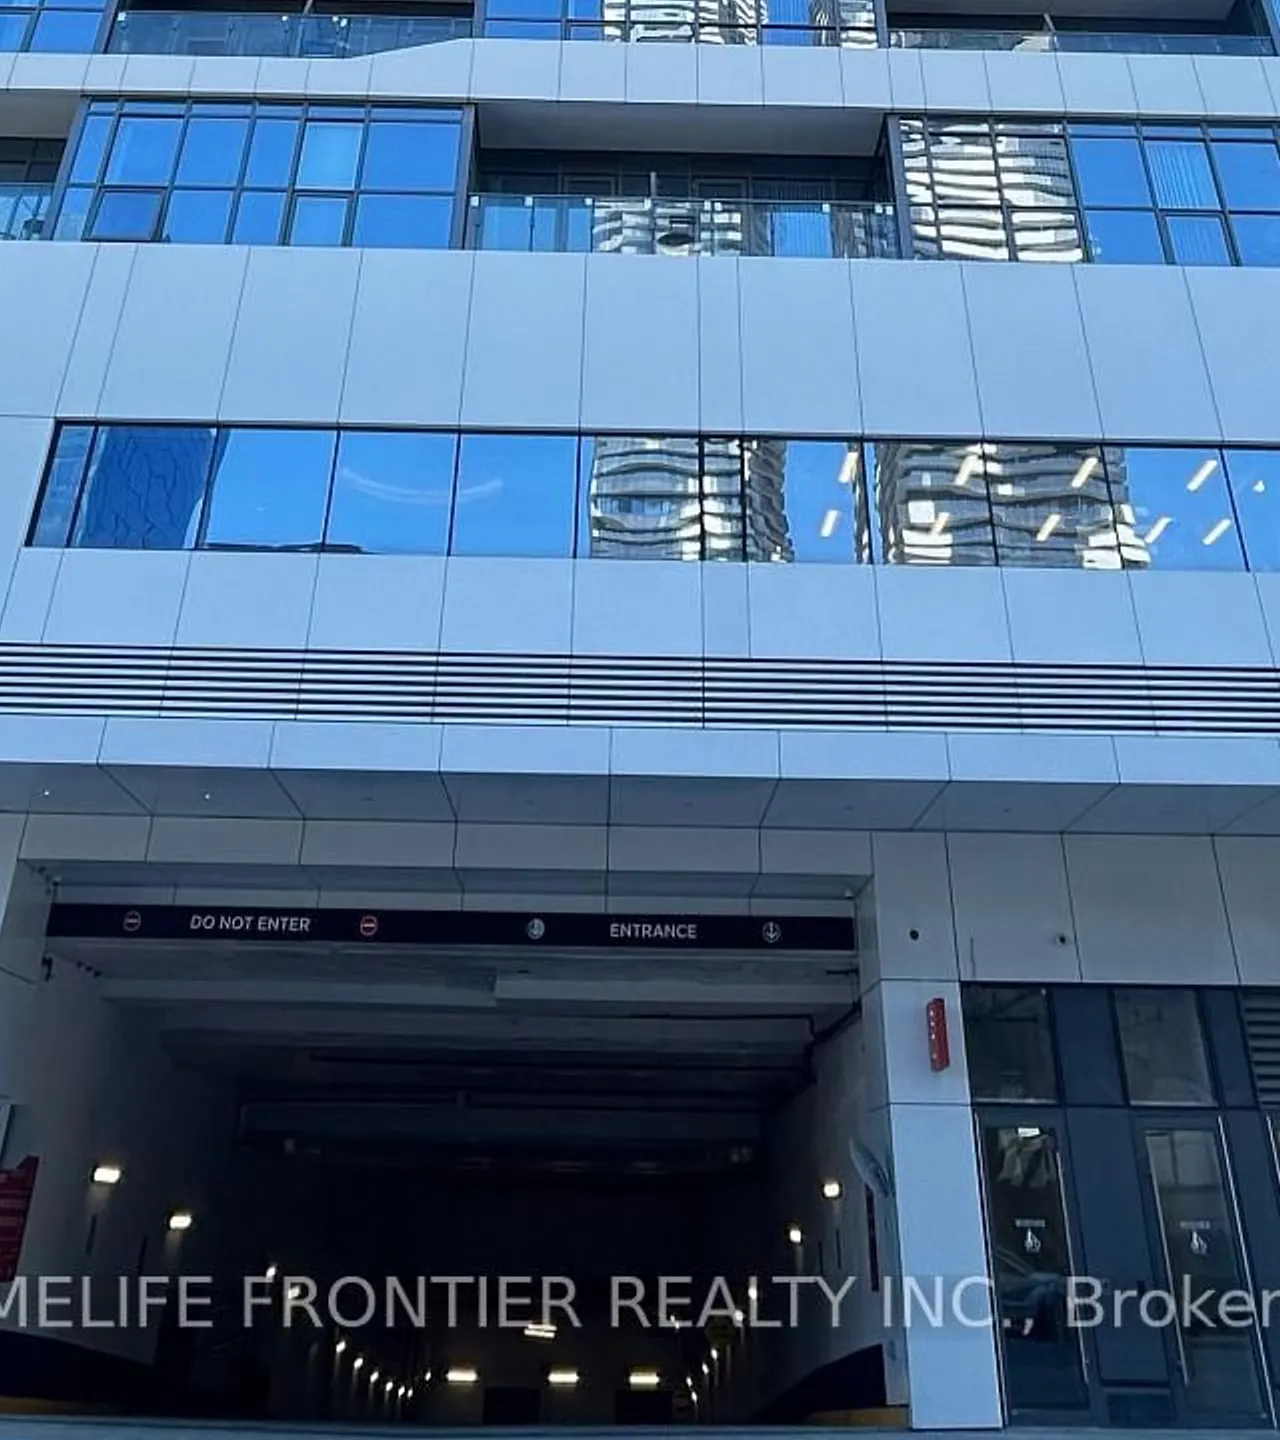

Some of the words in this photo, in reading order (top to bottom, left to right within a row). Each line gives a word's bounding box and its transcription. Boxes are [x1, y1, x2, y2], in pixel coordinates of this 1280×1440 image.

[190, 915, 216, 929] DO
[220, 915, 254, 930] NOT
[258, 916, 311, 931] ENTER
[610, 923, 697, 939] ENTRANCE
